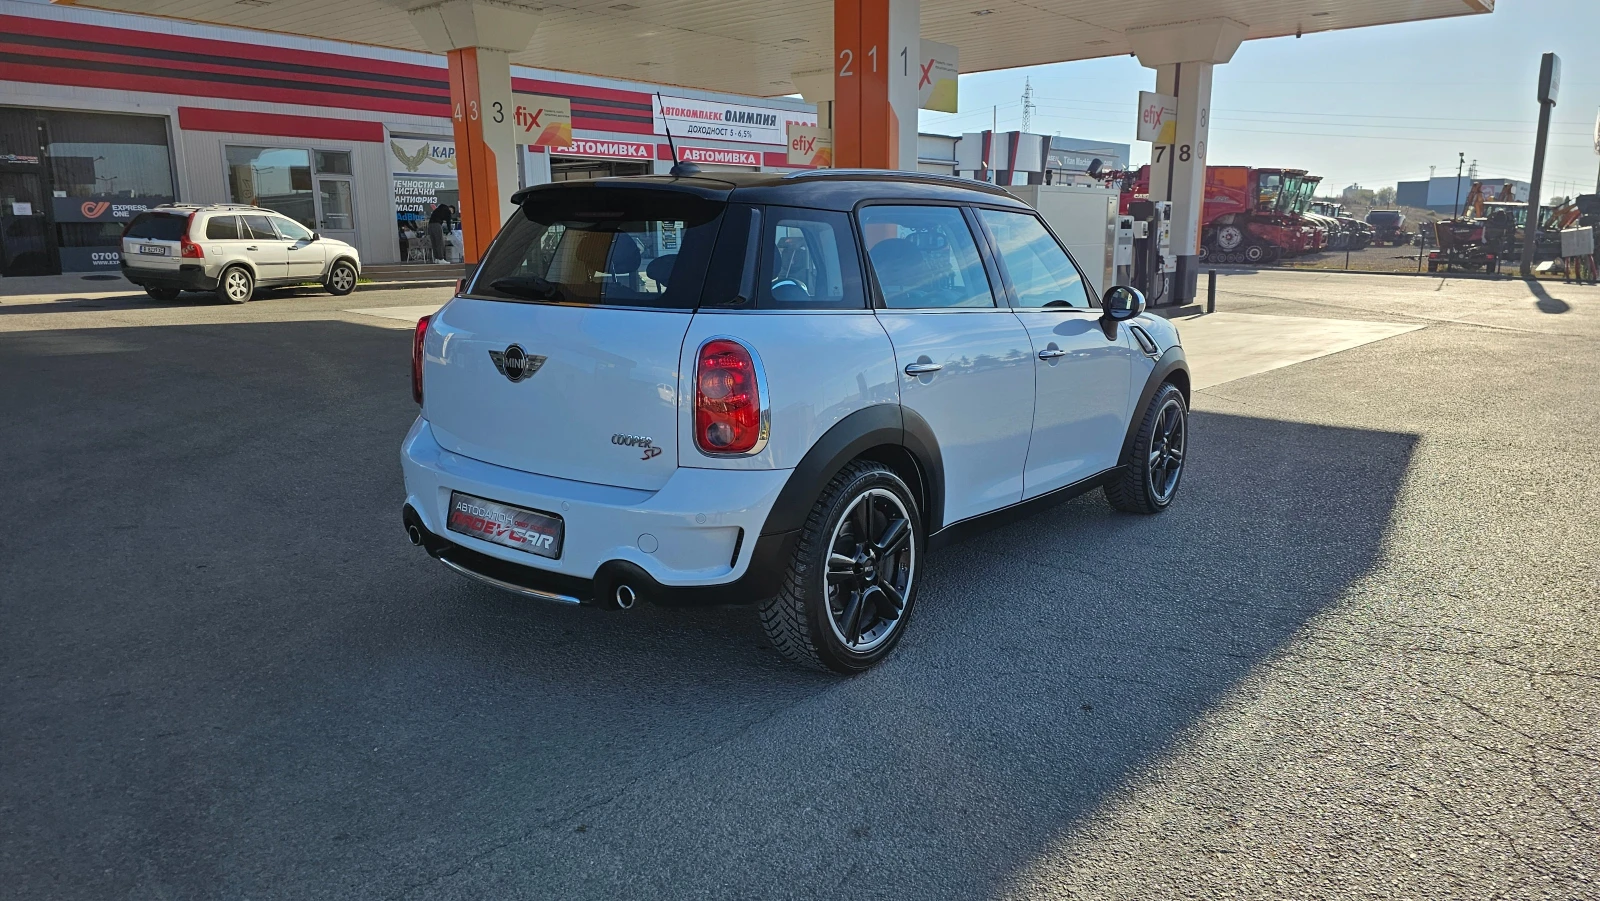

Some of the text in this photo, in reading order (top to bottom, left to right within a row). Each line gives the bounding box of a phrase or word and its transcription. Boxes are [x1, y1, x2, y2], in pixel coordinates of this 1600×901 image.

[839, 49, 853, 77] 2
[868, 45, 877, 73] 1
[900, 46, 907, 76] 1
[454, 103, 463, 122] 4
[469, 101, 479, 121] 3
[492, 101, 505, 124] 3
[513, 105, 544, 132] fix
[660, 105, 777, 127] АВТОКОМПЛЕКС ОЛИМПИЯ
[1143, 104, 1164, 130] efix
[687, 124, 728, 136] ДОХОДНОСТ
[432, 145, 456, 159] КАР
[792, 135, 816, 155] efix
[1154, 145, 1167, 163] 7
[1178, 144, 1191, 162] 8
[683, 149, 756, 164] АВТОМИВКА
[434, 181, 445, 189] ЗА
[395, 195, 438, 204] АНТИФРИЗ
[396, 212, 426, 221] AdBlue
[91, 252, 120, 260] 0700
[1163, 278, 1170, 295] 8
[505, 357, 526, 369] MINI
[611, 433, 653, 448] COOPER
[640, 446, 662, 460] SD
[456, 501, 514, 525] АВТОСАЛОН
